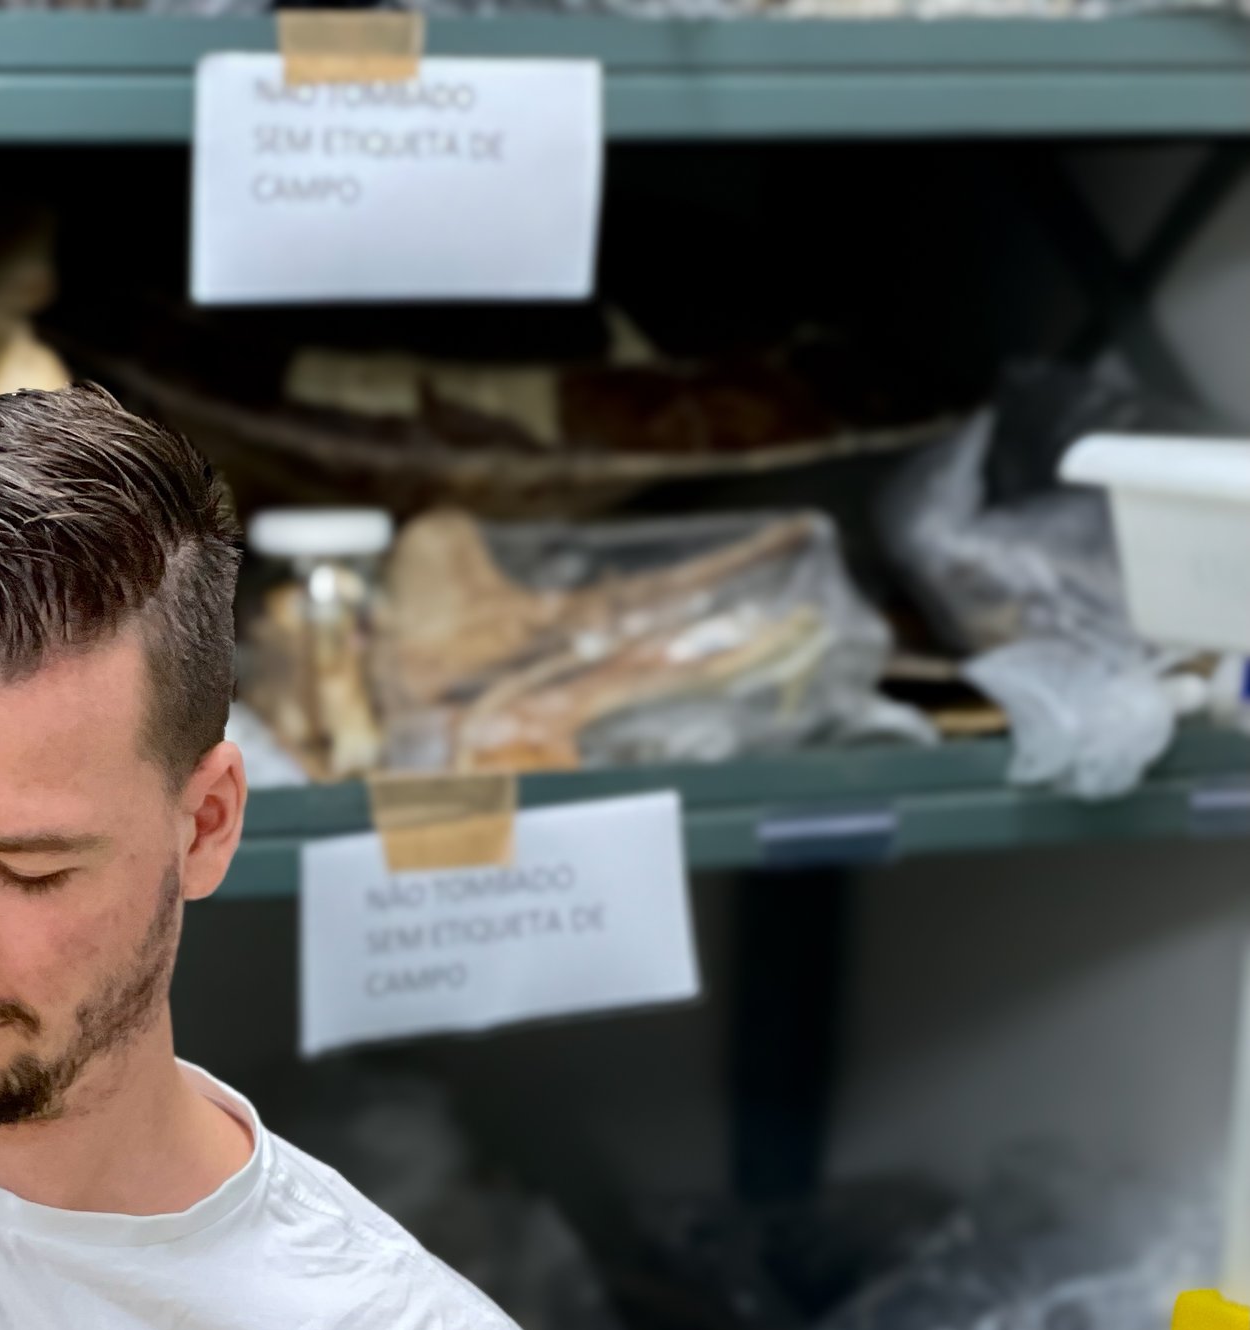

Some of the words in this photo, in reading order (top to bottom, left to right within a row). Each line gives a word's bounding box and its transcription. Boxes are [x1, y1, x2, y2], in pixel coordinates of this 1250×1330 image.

[254, 127, 313, 156] SEM
[323, 128, 458, 160] ETIQUETA
[469, 131, 507, 161] DE
[251, 175, 363, 205] CAMPO
[365, 926, 425, 957] SEM
[432, 908, 564, 945] ETIQUETA
[570, 904, 607, 935] DE
[364, 963, 469, 998] CAMPO
